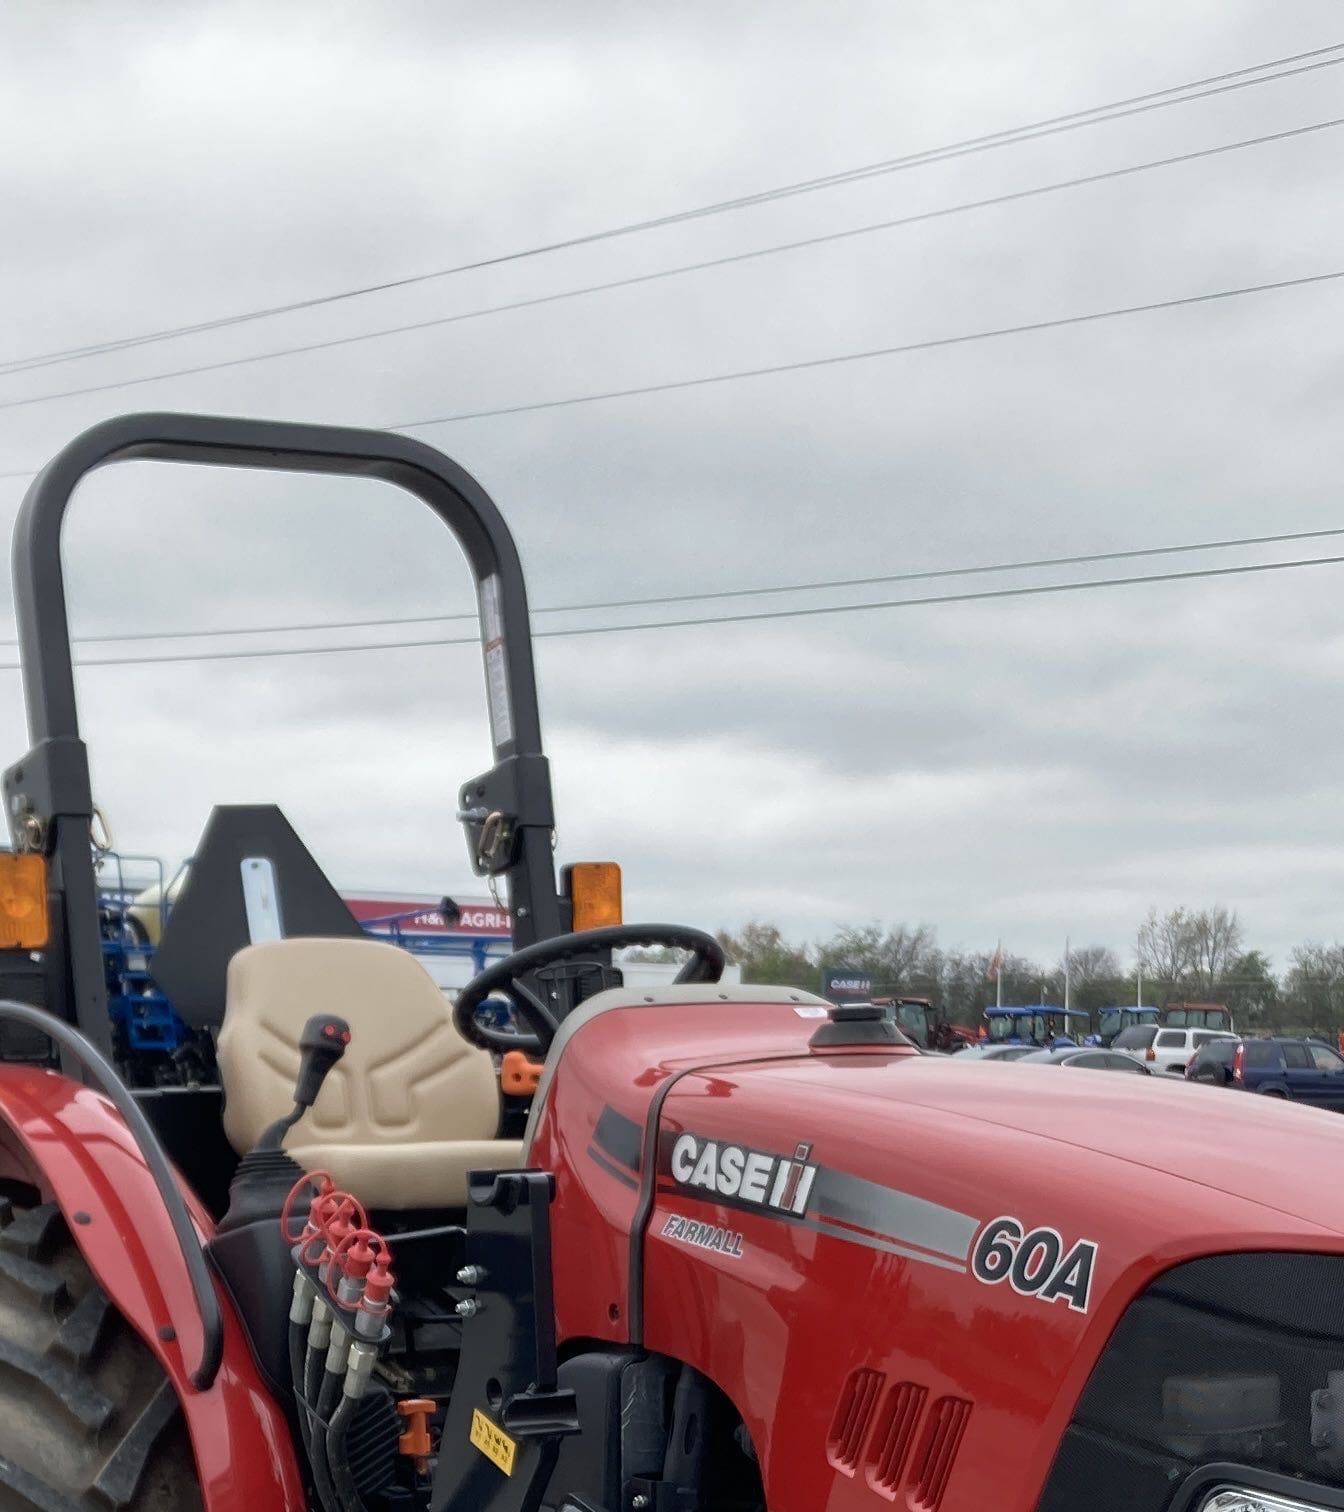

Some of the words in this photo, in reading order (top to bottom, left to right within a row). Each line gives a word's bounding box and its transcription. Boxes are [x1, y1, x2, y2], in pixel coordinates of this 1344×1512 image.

[671, 1134, 774, 1204] CASE
[661, 1213, 744, 1259] FARMALL
[971, 1215, 1099, 1315] 60A
